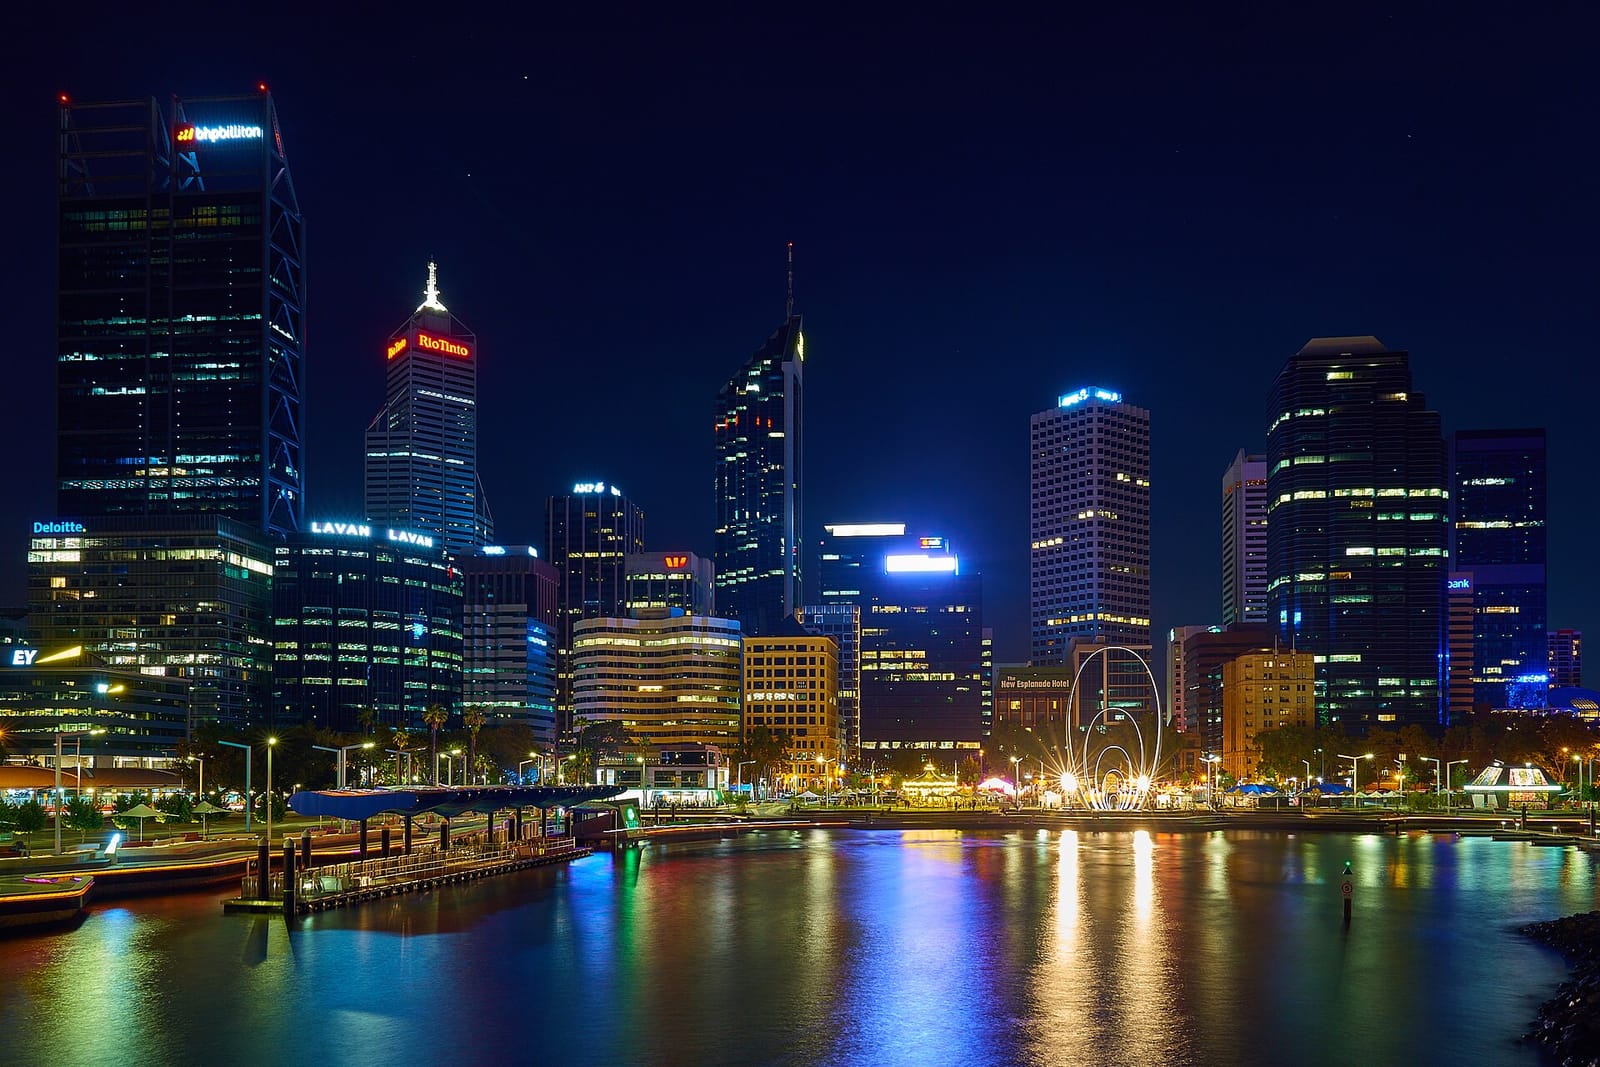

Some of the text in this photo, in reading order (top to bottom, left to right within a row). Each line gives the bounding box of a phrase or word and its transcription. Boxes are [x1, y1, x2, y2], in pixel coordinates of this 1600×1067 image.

[195, 125, 262, 143] bhpbilliton
[312, 522, 370, 536] LAVAN
[389, 529, 433, 547] LAVAN
[12, 649, 38, 666] EY
[1001, 680, 1016, 688] New
[1017, 680, 1051, 689] Esplanade
